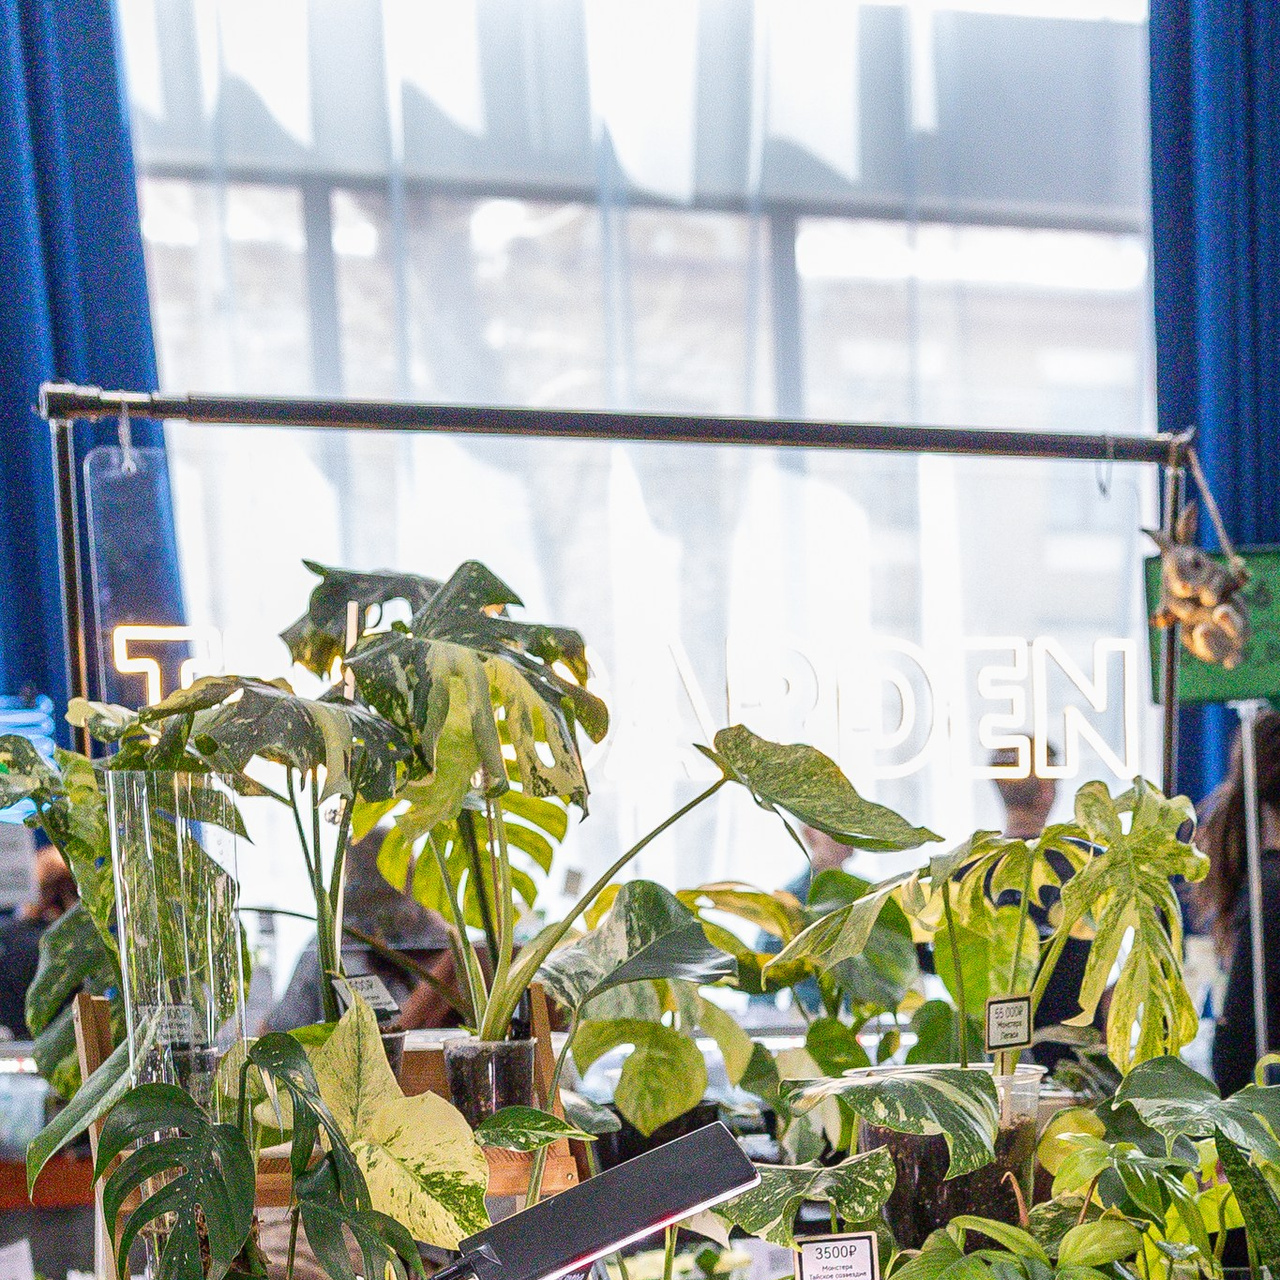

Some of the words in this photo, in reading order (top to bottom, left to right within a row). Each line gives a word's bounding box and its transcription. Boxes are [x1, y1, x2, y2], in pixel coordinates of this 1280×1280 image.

[816, 1245, 857, 1260] 3500₽
[822, 1263, 852, 1273] Монстера
[810, 1271, 833, 1280] Тайское
